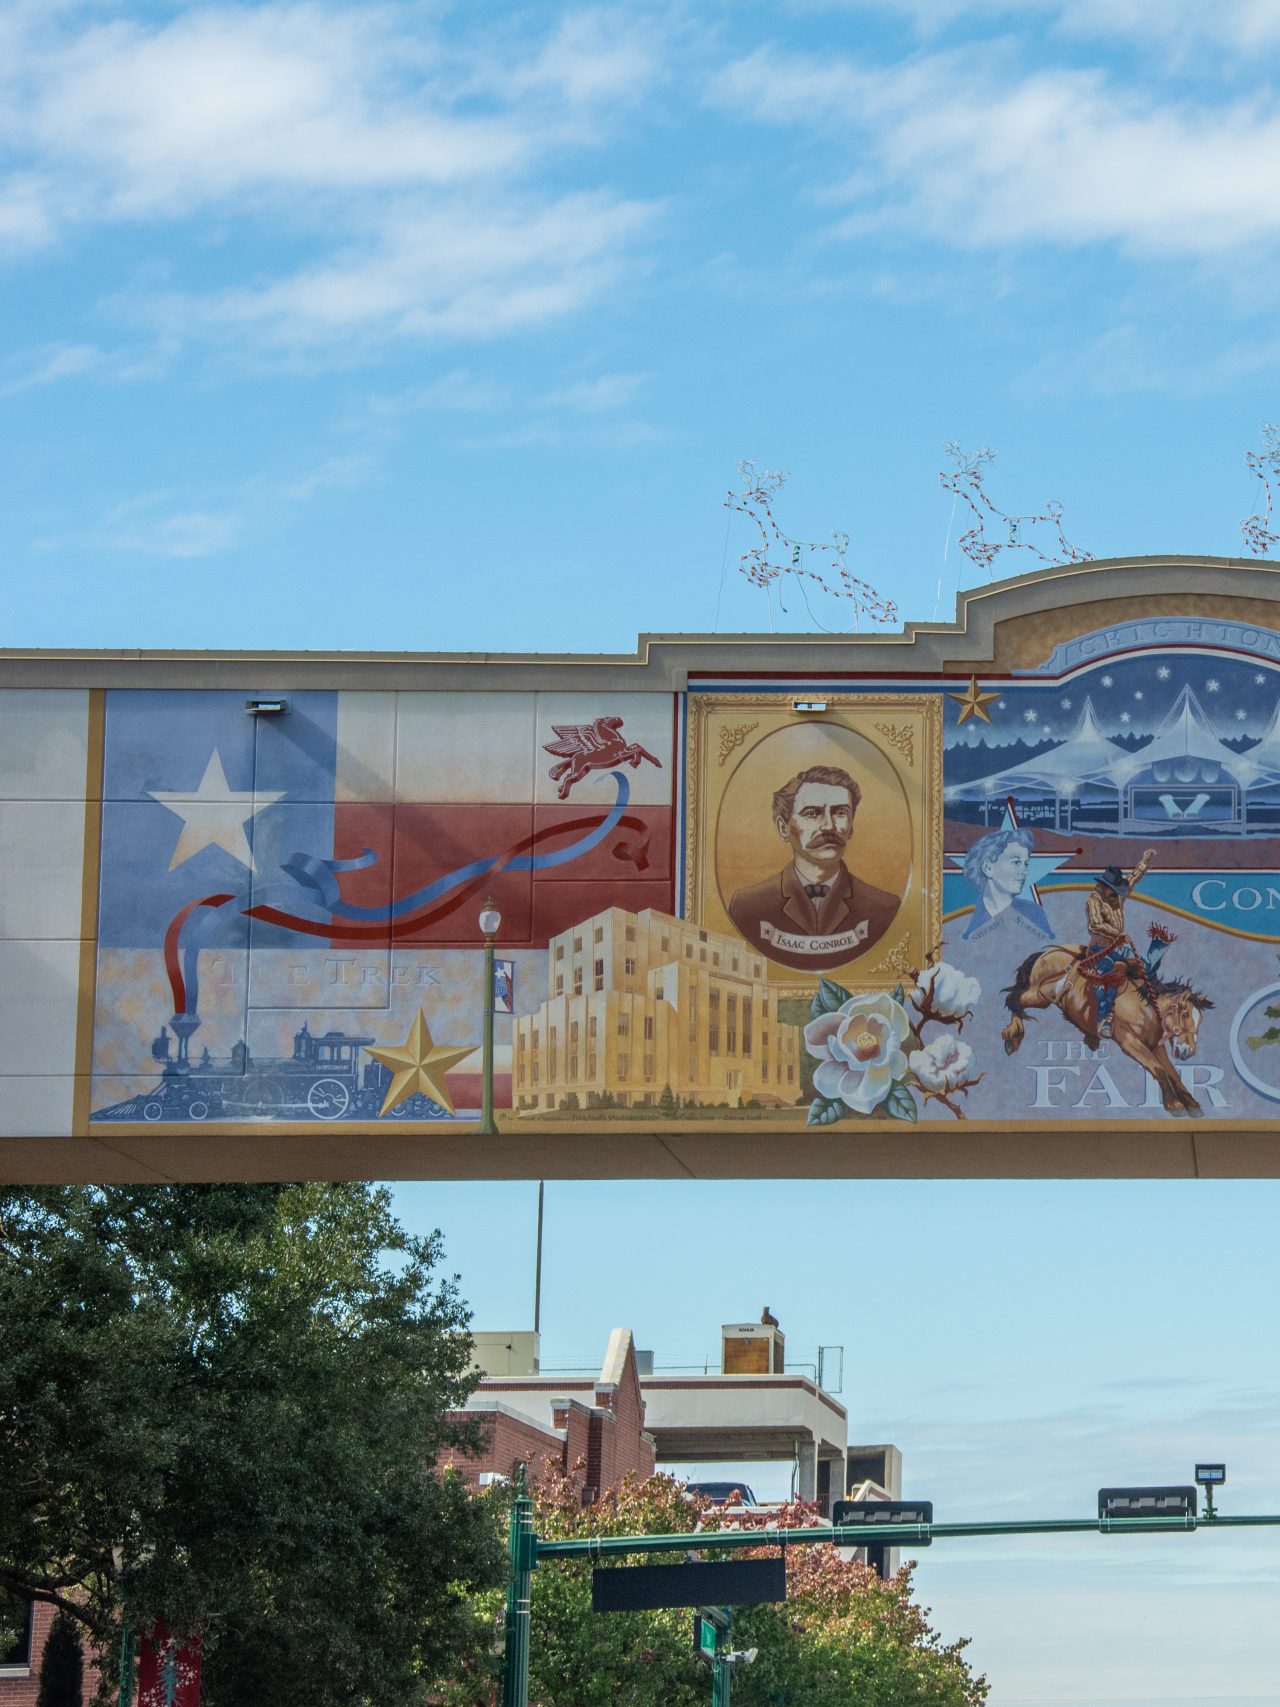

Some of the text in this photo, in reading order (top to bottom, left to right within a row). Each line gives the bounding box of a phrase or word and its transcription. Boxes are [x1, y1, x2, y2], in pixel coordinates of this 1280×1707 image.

[776, 935, 855, 951] ISAAC CONROE
[323, 957, 445, 986] TREK
[1037, 1040, 1112, 1061] THE
